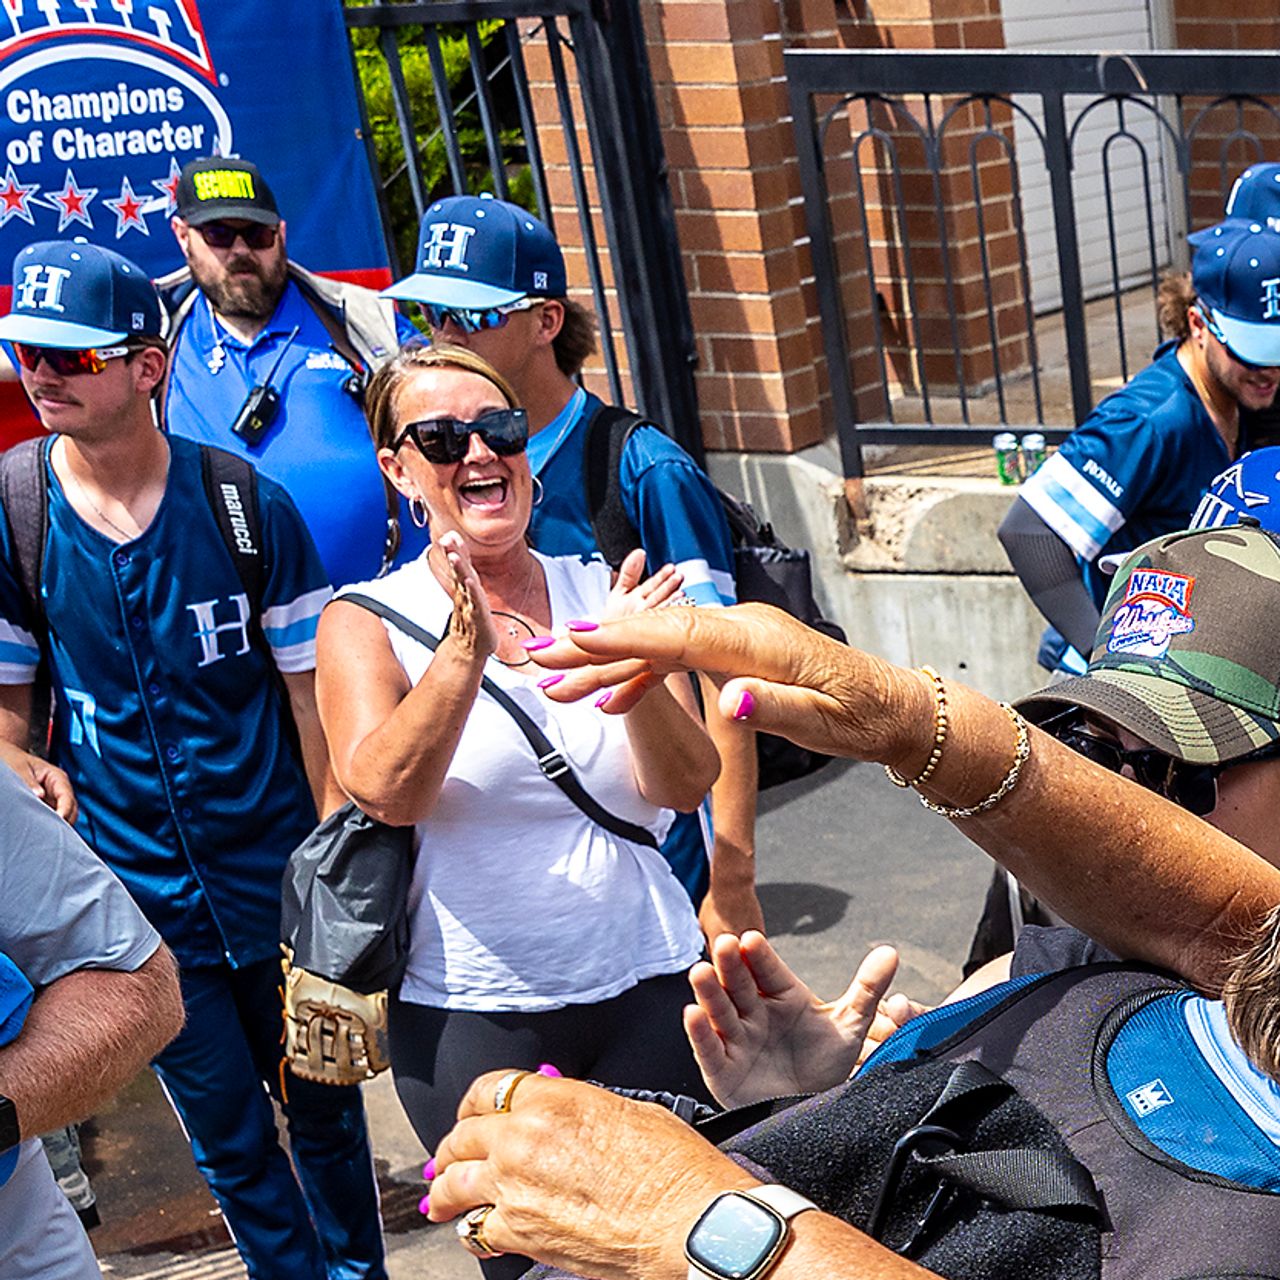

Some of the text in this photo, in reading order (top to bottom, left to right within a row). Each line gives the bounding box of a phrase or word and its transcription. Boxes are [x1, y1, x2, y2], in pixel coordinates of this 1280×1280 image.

[6, 83, 185, 124] Champions
[6, 120, 204, 165] of Character
[193, 169, 256, 201] SECURITY
[423, 222, 476, 272] H
[16, 264, 72, 313] H
[220, 483, 257, 556] marucci
[1128, 573, 1187, 607] NAIA
[185, 592, 250, 668] H
